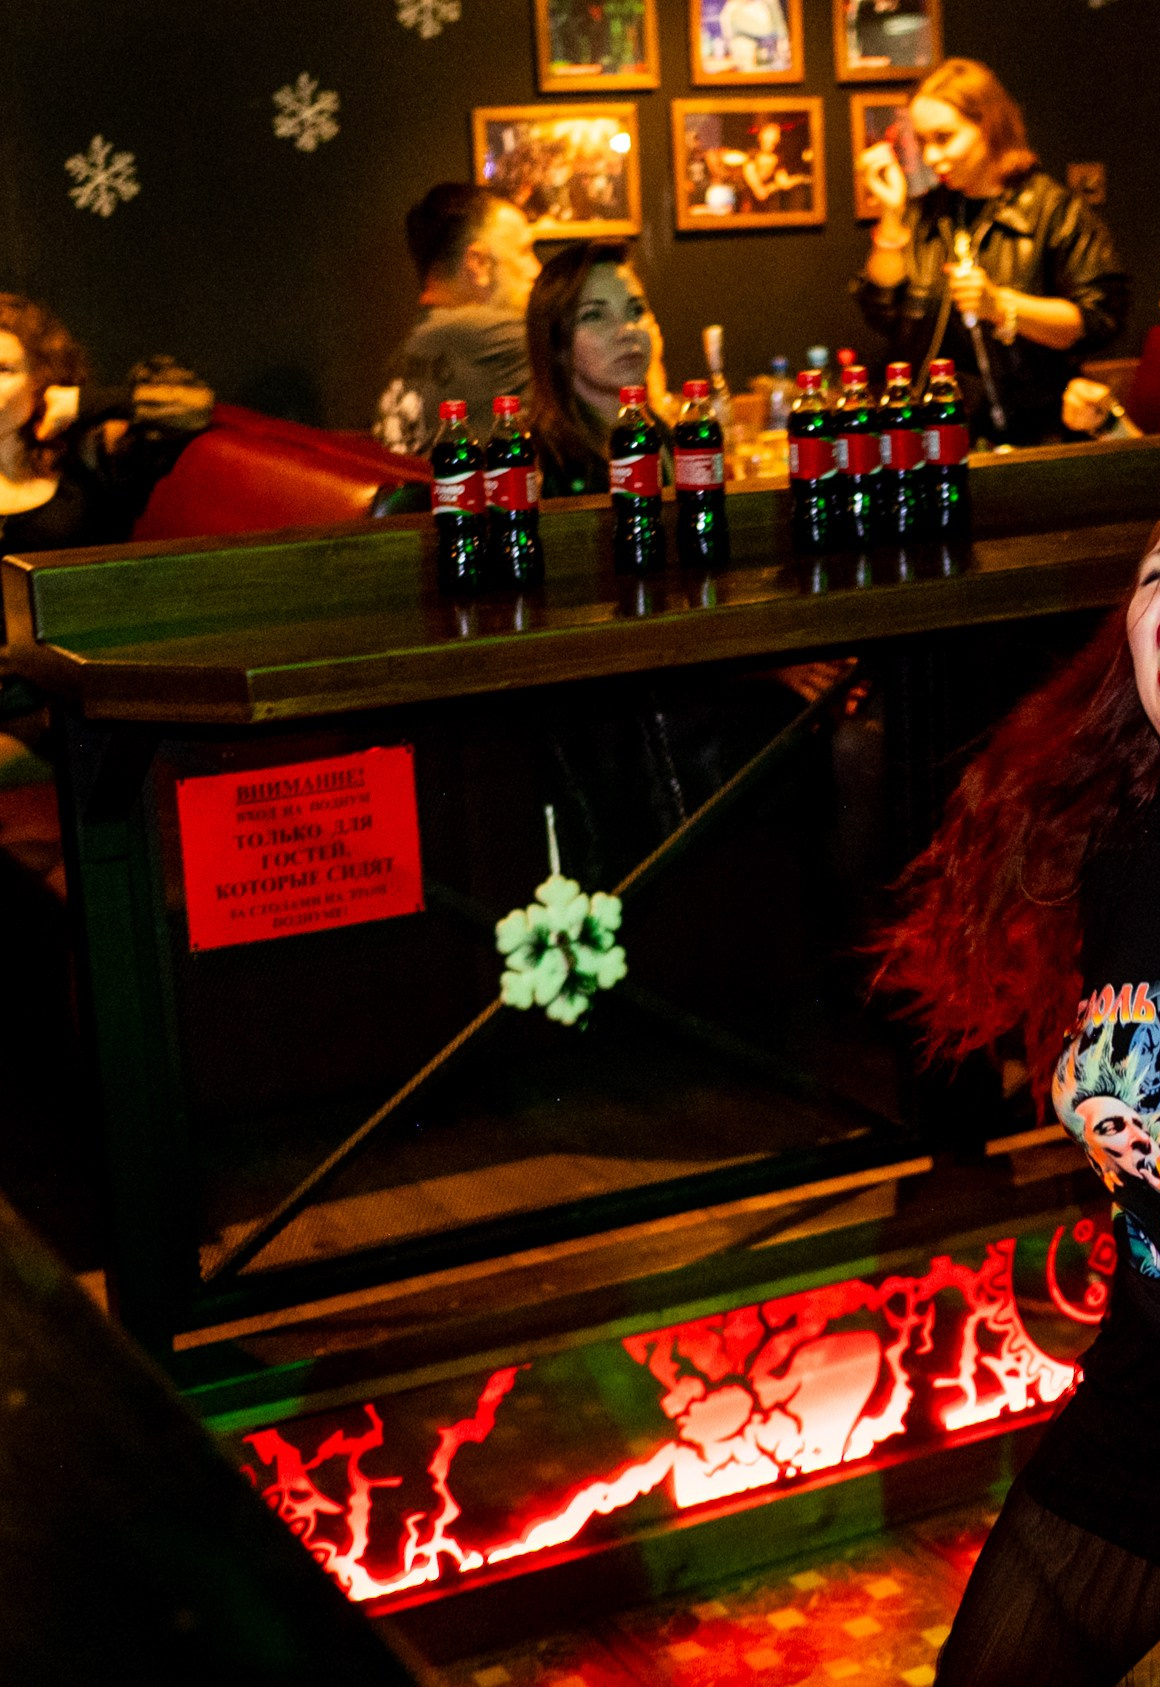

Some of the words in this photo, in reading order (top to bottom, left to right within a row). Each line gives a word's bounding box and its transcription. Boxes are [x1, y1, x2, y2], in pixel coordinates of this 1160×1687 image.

[237, 769, 365, 803] ВНИМАНИЕ!
[234, 823, 322, 850] ТОЛЬКО
[333, 814, 374, 838] ДЛЯ
[215, 871, 320, 901] КОТОРЫЕ
[327, 858, 395, 884] СИДЯТ
